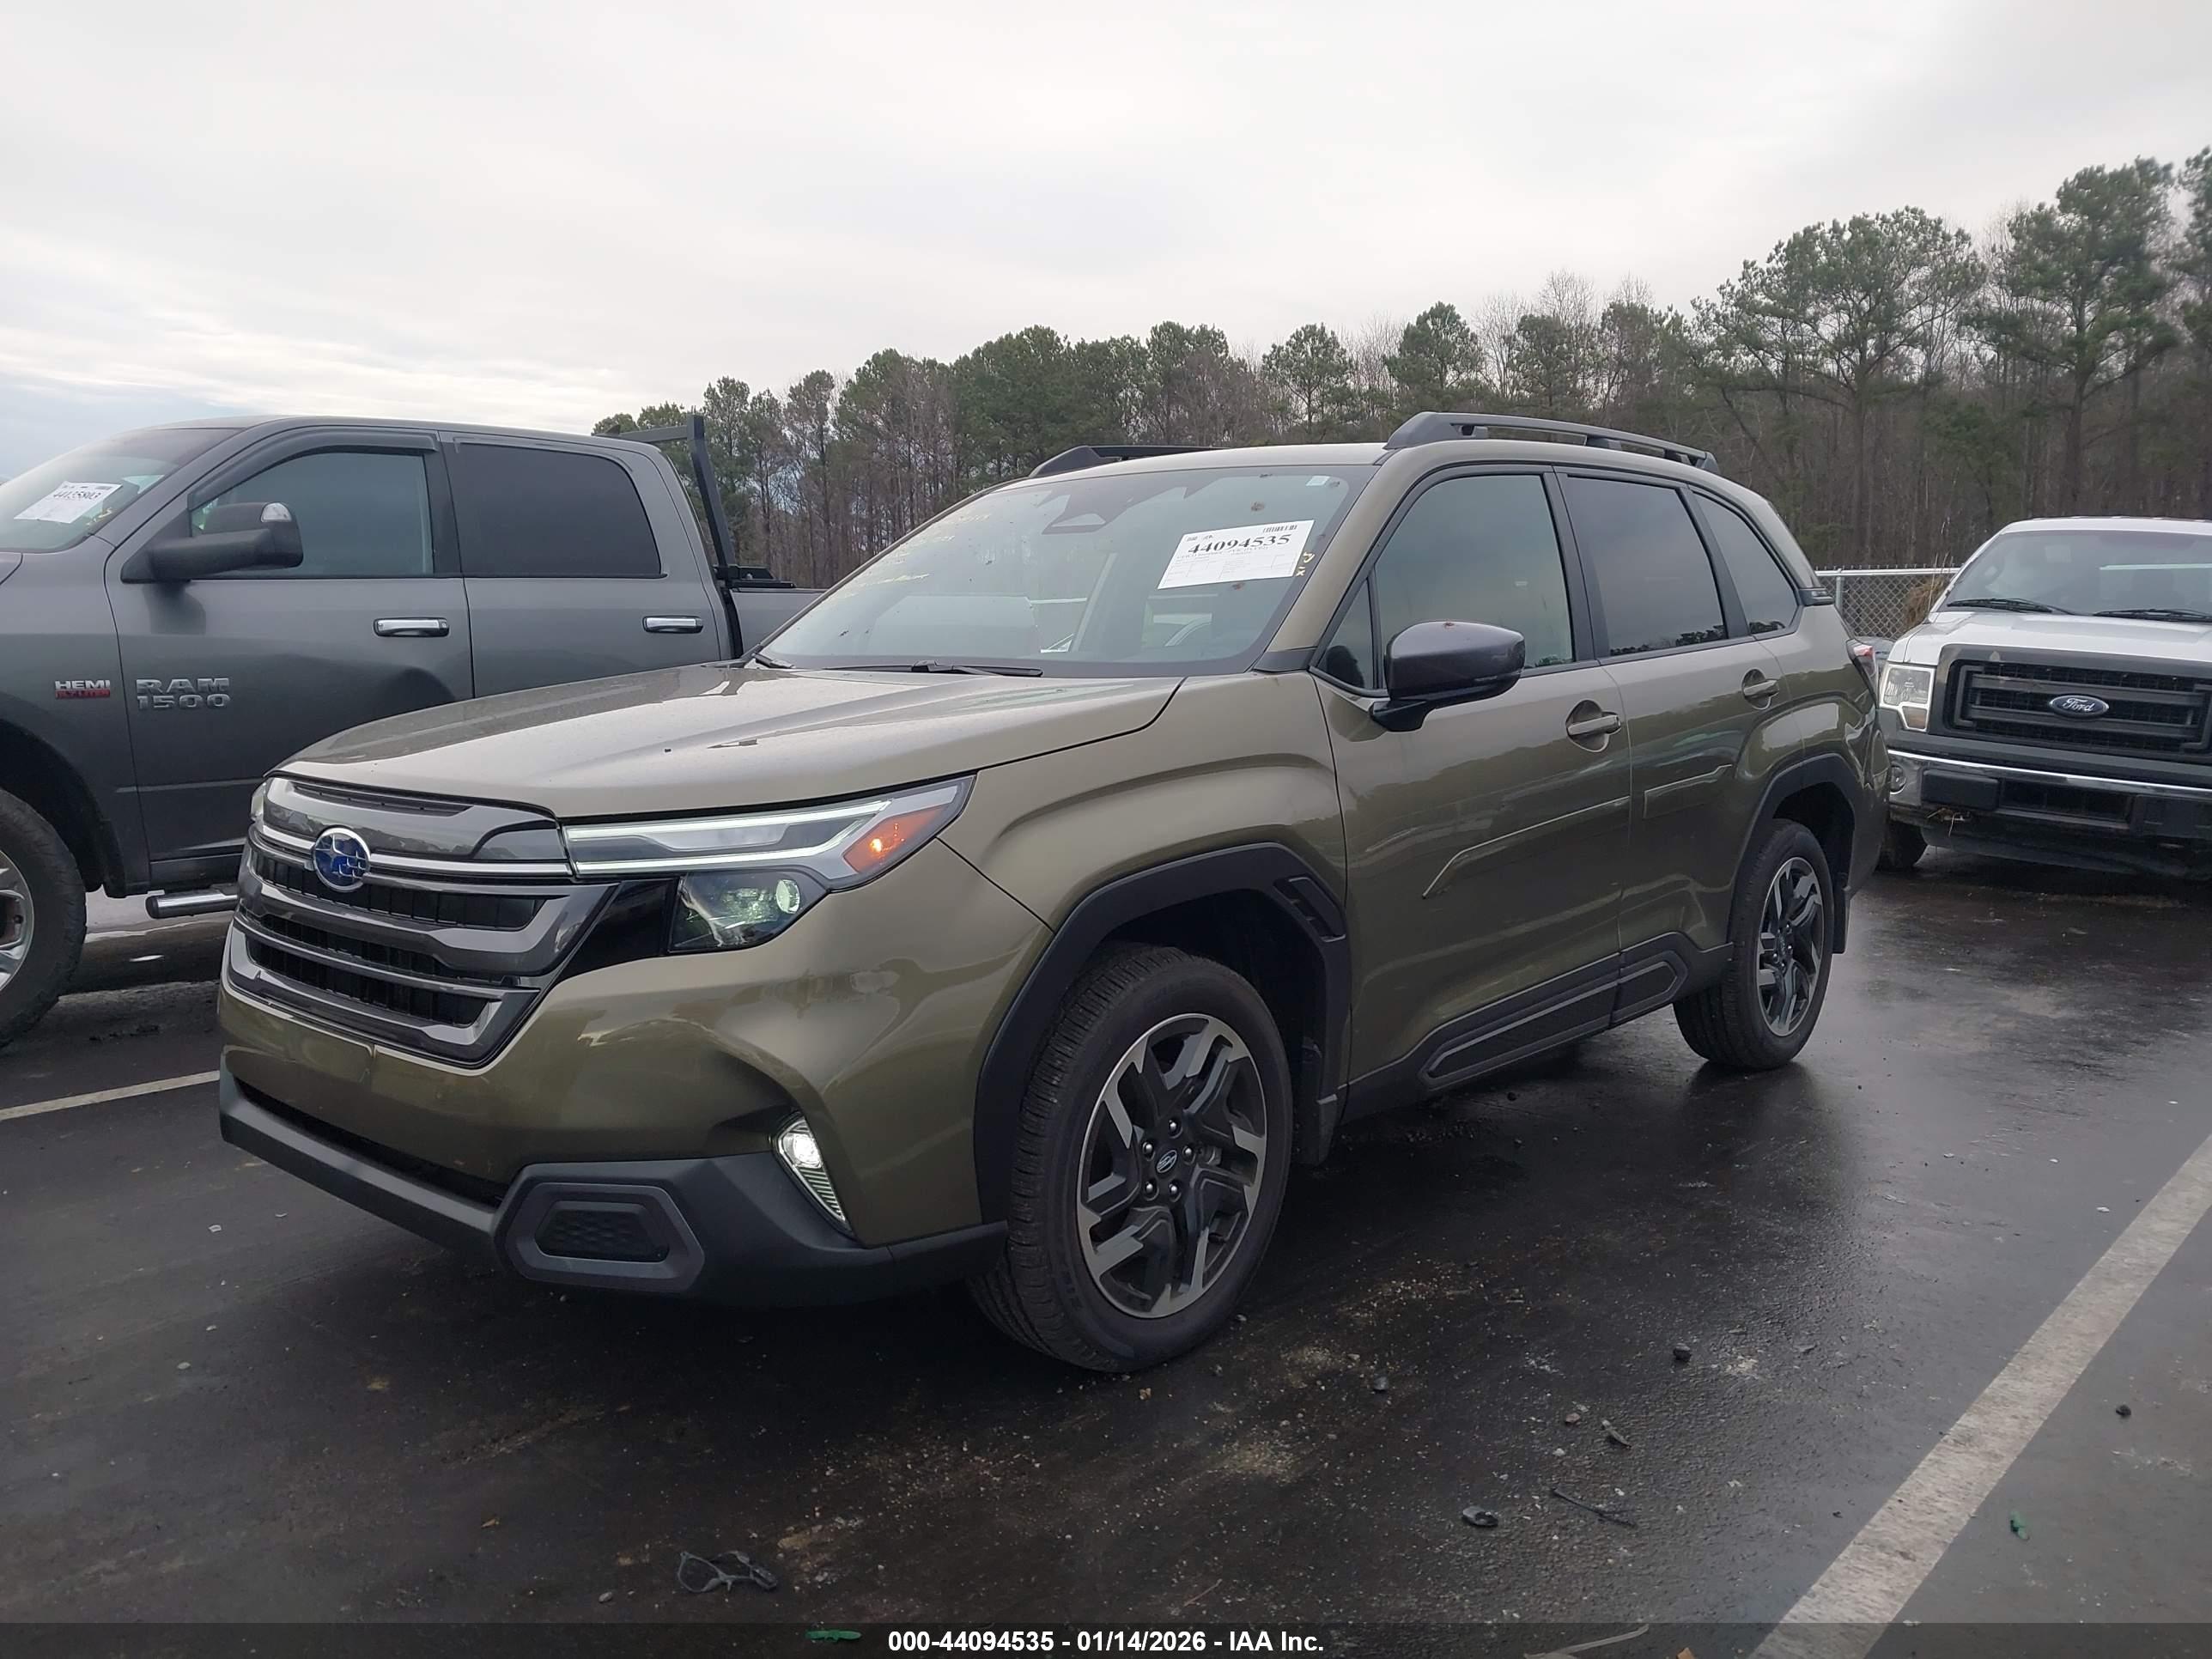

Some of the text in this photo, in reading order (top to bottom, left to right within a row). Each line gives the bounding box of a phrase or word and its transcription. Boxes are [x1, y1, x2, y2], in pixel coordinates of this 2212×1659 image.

[1188, 533, 1291, 554] 44094535
[54, 679, 111, 690] HEMI
[136, 677, 230, 694] RAM
[136, 693, 231, 710] 1500
[2062, 697, 2095, 711] Ford
